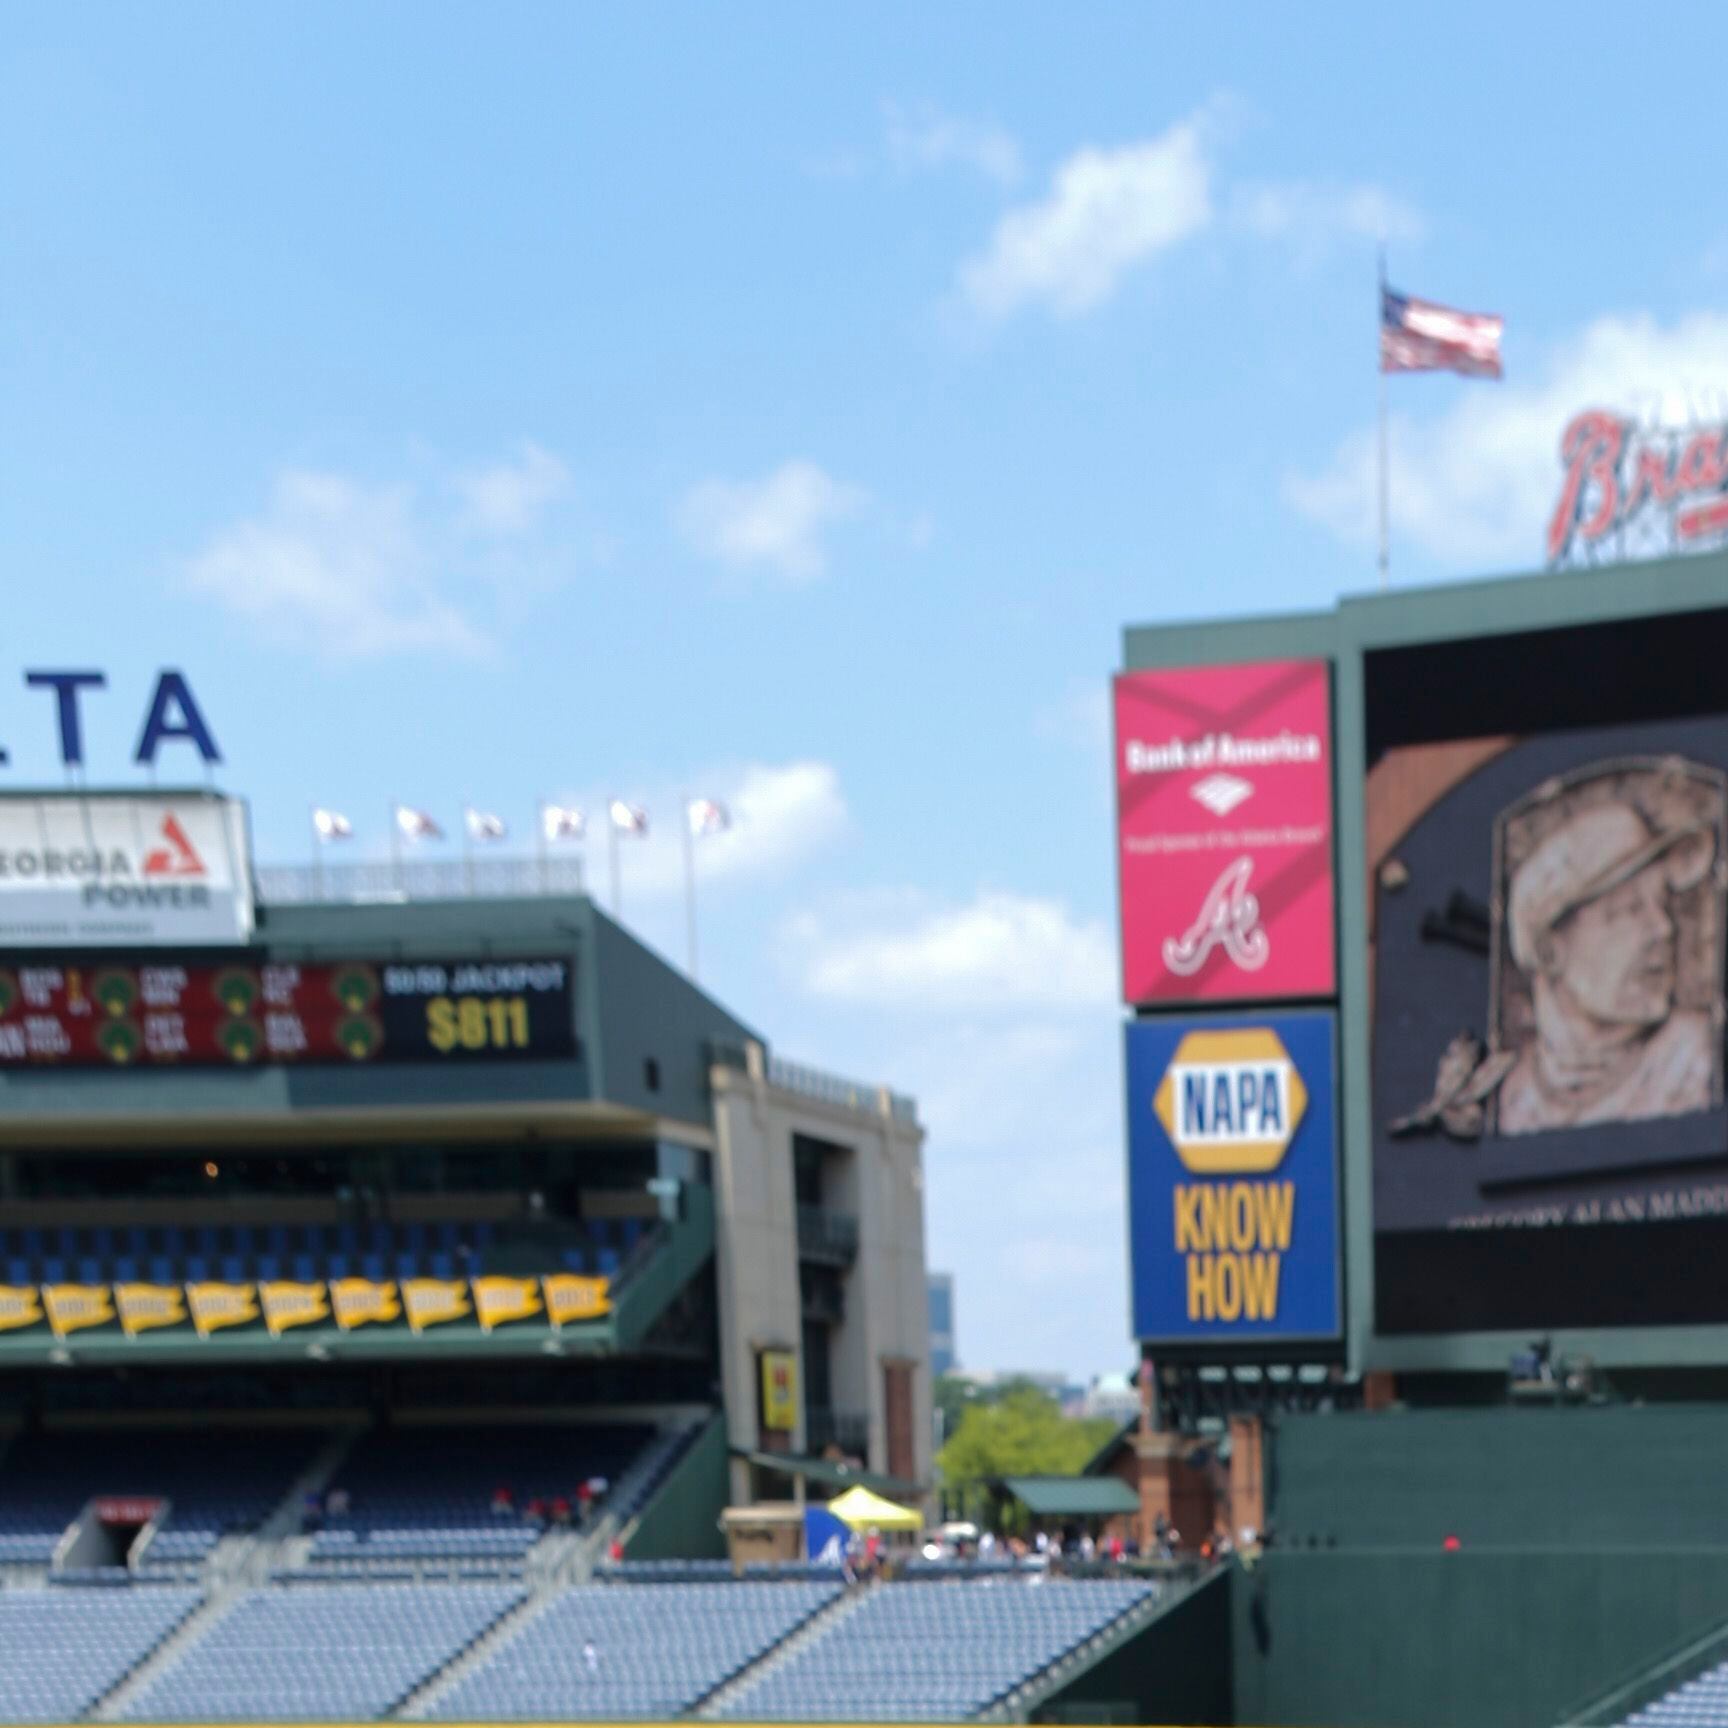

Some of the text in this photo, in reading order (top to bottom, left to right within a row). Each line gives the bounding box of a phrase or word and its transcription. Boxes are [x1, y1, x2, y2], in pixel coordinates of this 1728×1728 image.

[0, 668, 221, 765] TA
[1127, 730, 1320, 773] Bank of America
[426, 997, 529, 1052] $811
[1183, 1071, 1281, 1135] NAPA
[1174, 1181, 1294, 1252] KNOW
[1187, 1252, 1280, 1322] HOW
